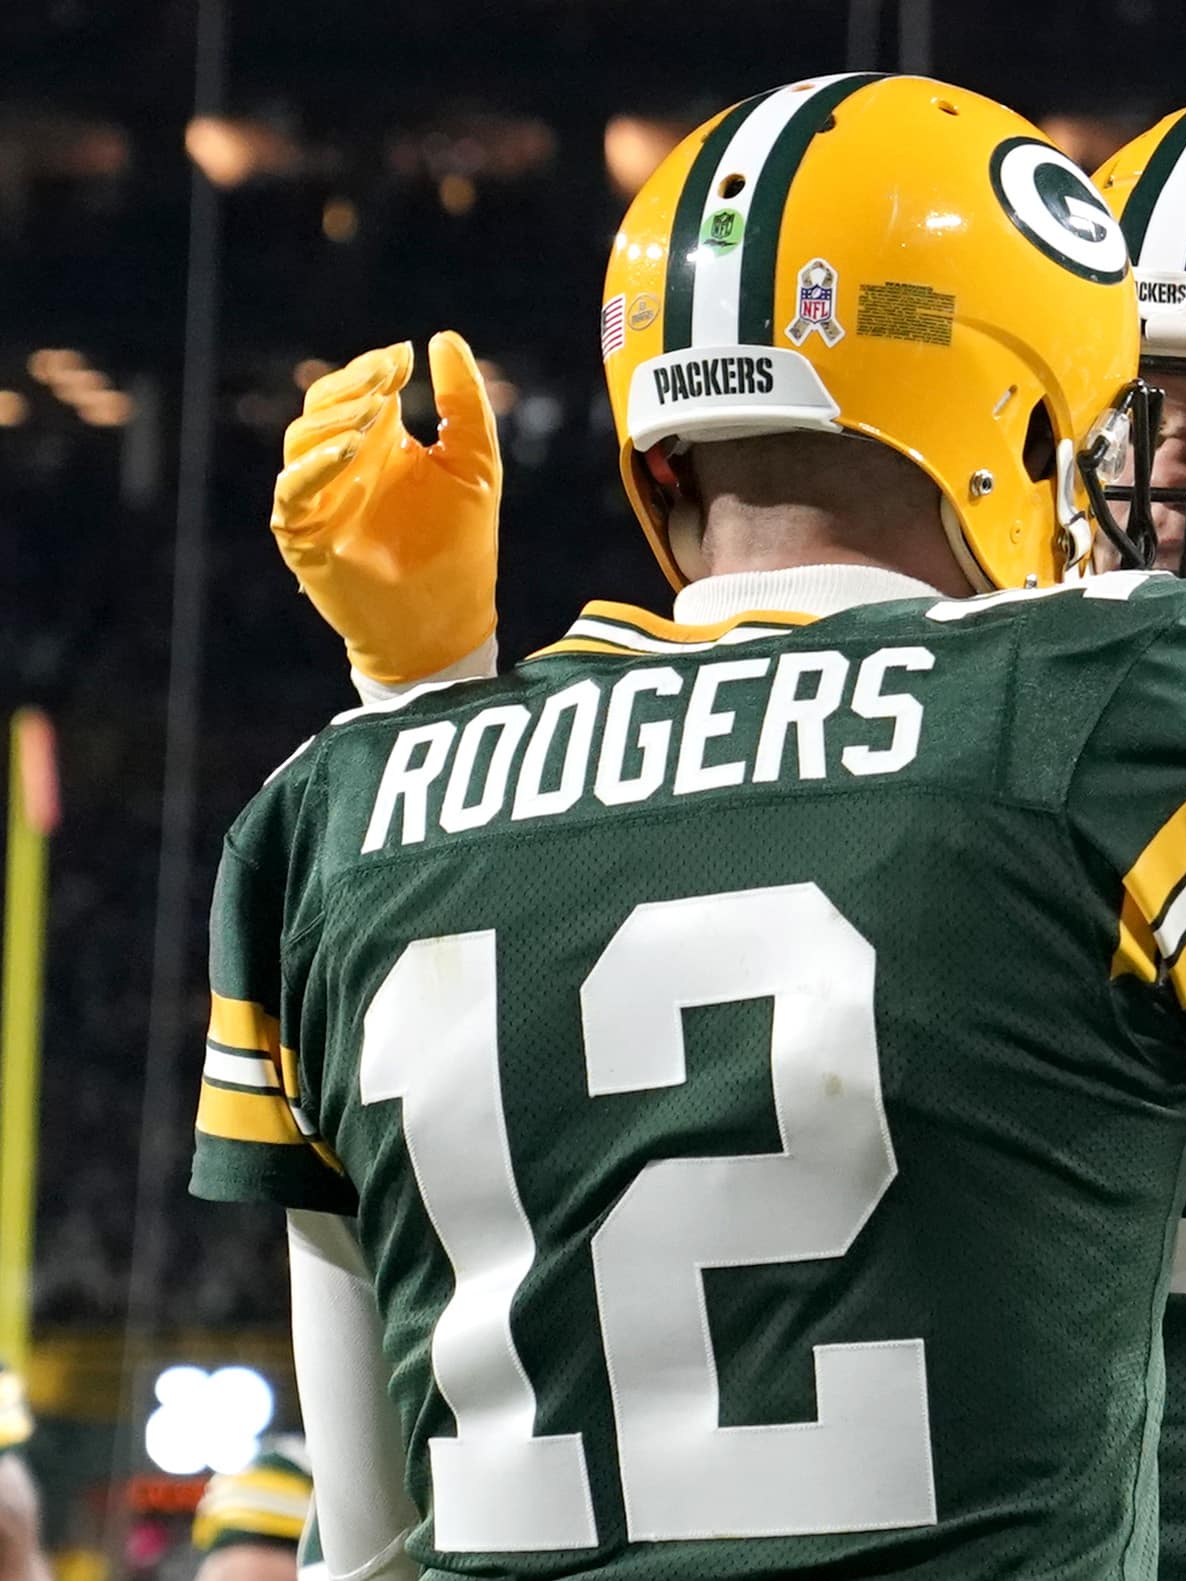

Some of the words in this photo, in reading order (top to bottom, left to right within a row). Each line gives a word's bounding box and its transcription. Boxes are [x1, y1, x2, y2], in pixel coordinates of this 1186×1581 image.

[989, 136, 1129, 285] G
[802, 300, 829, 320] NFL
[1136, 280, 1186, 304] CKERS
[653, 356, 774, 405] PACKERS
[361, 645, 936, 856] RODGERS
[360, 881, 938, 1553] 12
